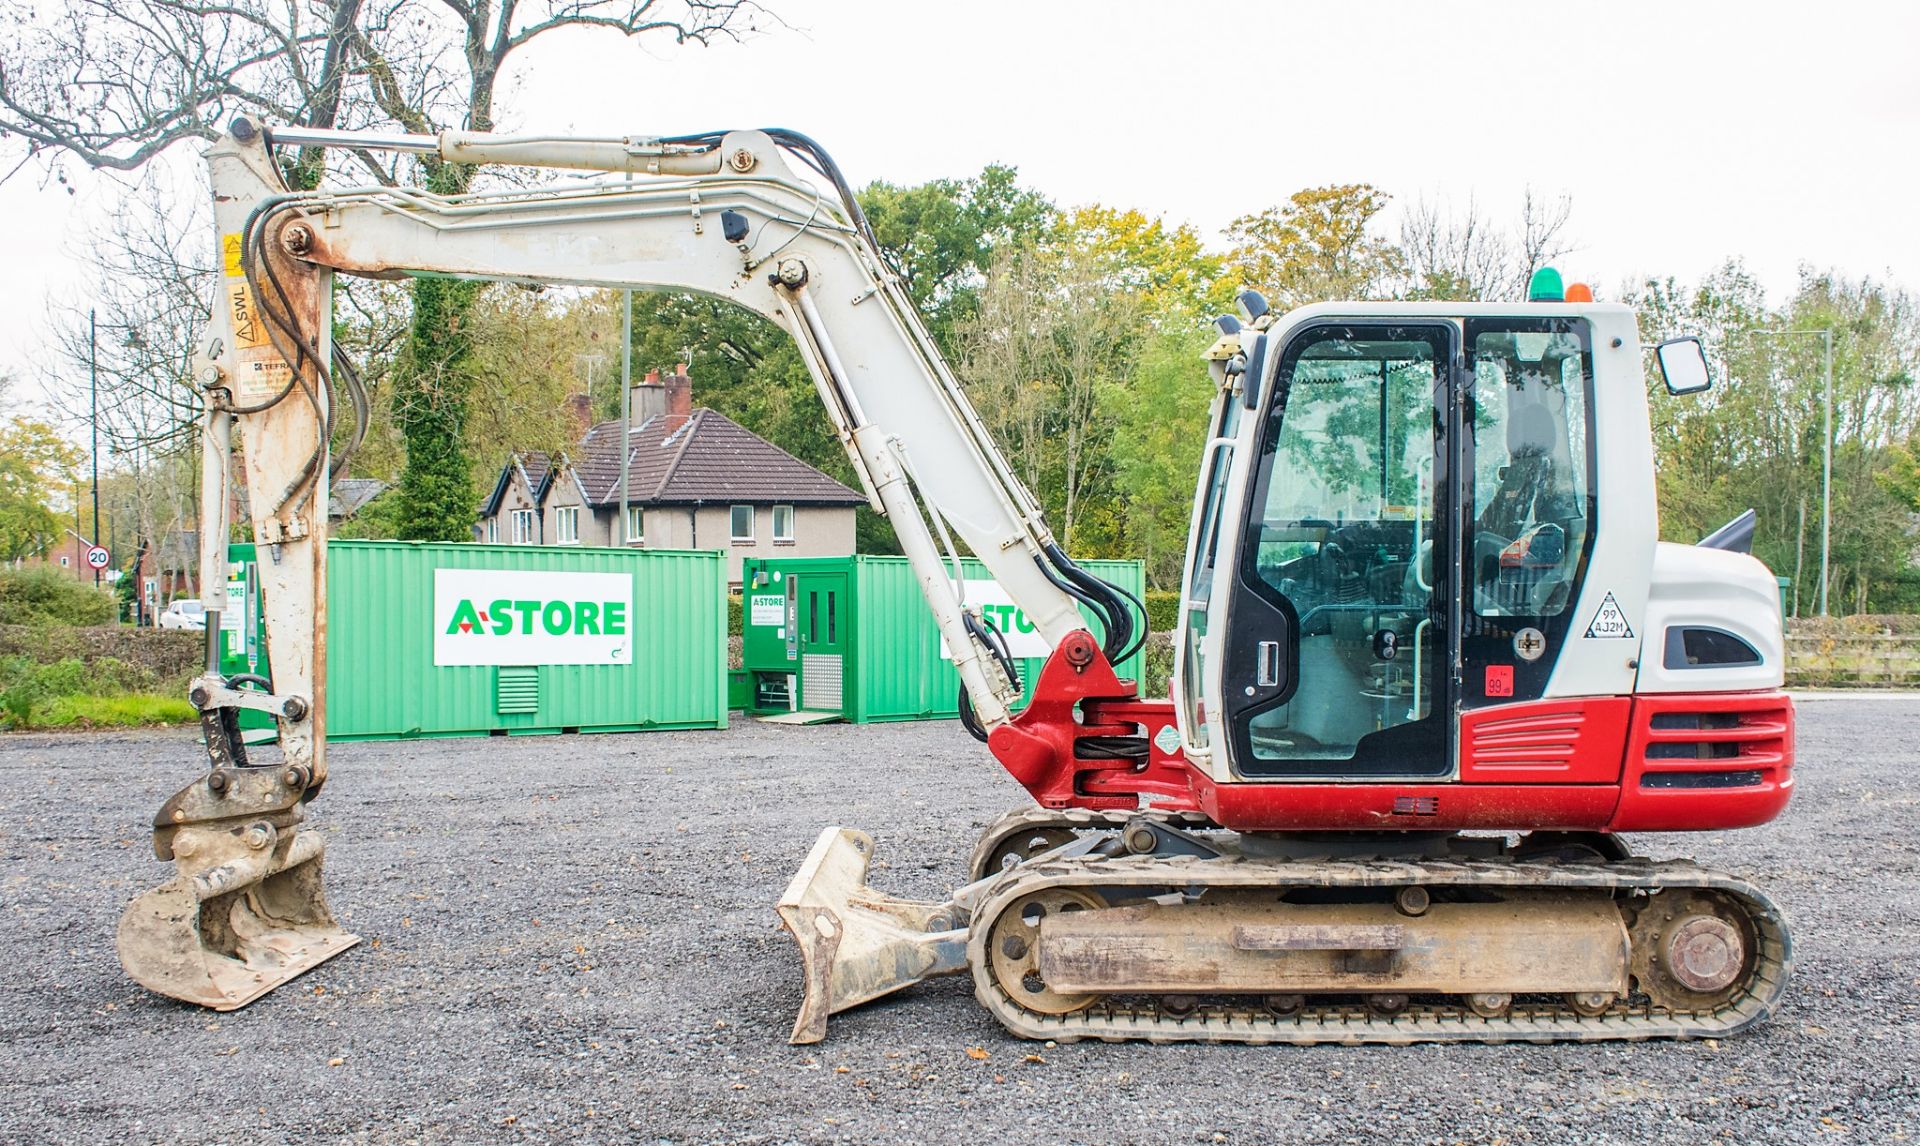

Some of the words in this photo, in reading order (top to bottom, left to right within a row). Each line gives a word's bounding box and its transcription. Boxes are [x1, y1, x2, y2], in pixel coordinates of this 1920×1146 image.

[233, 286, 249, 321] SWL
[90, 552, 107, 563] 20
[1602, 609, 1617, 620] 99
[1595, 622, 1623, 633] AJ2M
[1489, 679, 1502, 694] 99
